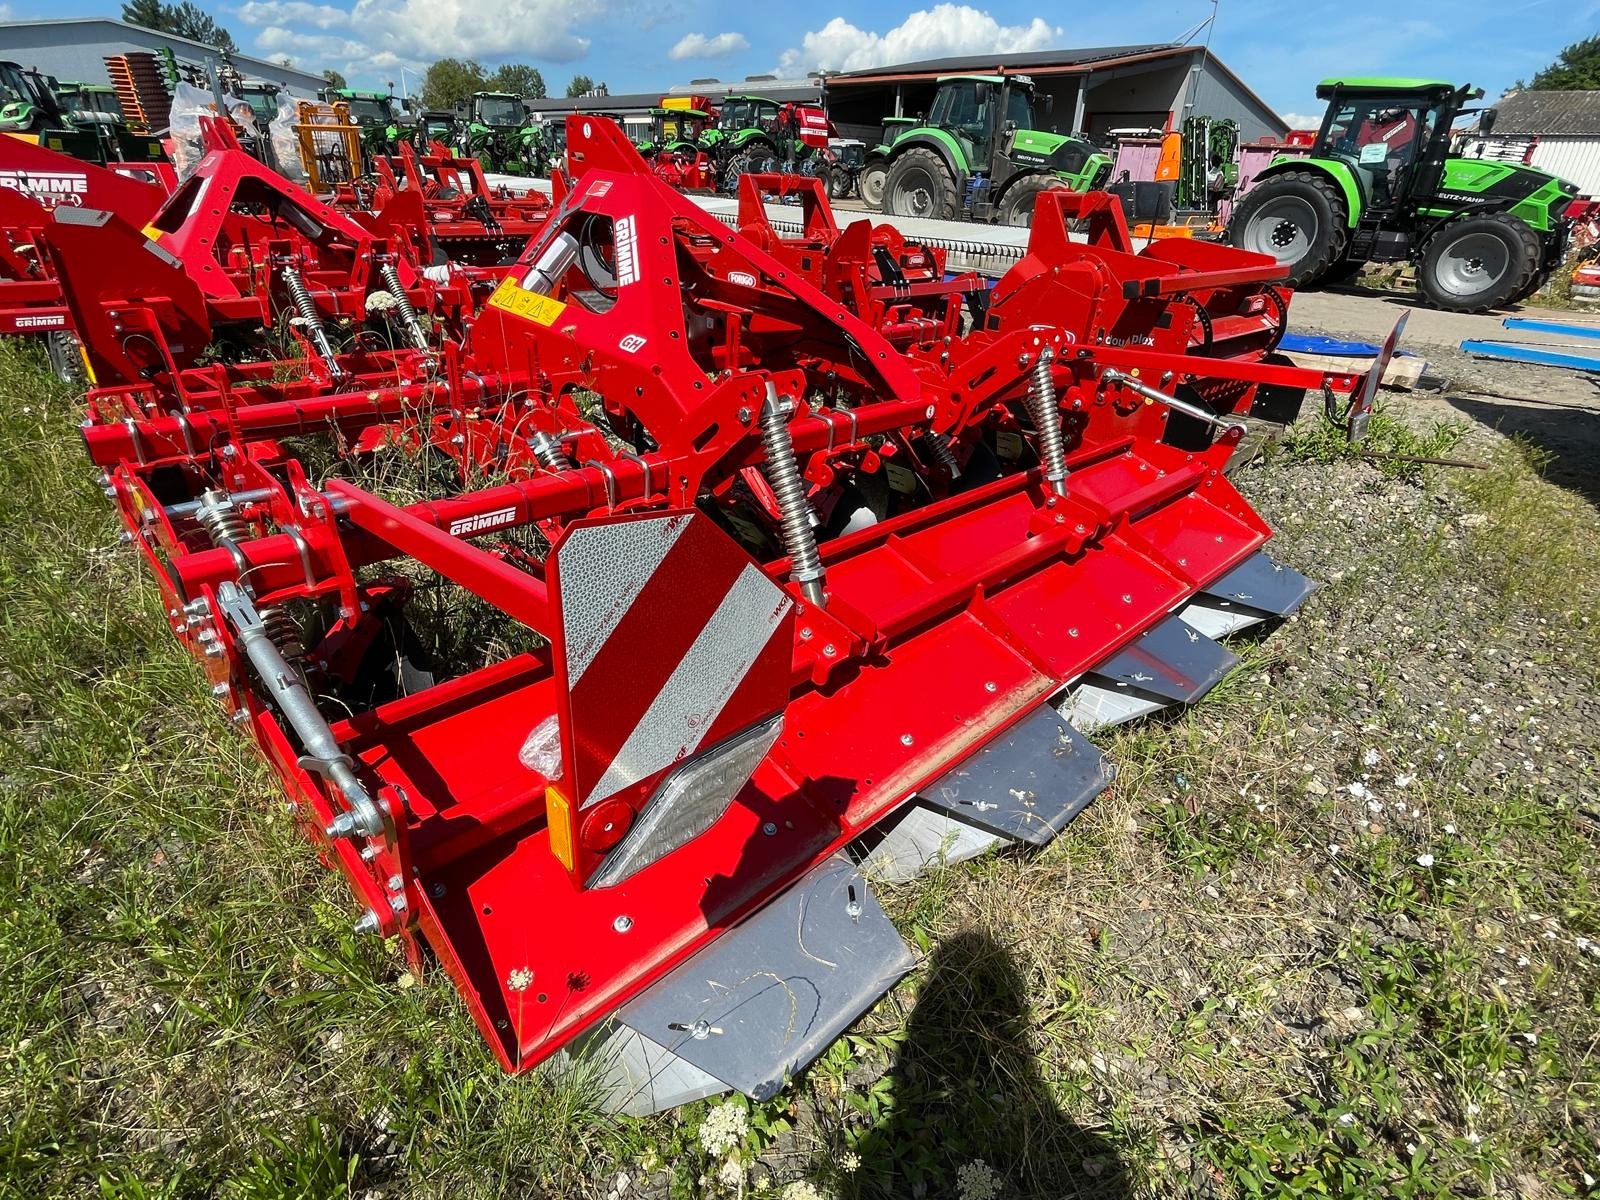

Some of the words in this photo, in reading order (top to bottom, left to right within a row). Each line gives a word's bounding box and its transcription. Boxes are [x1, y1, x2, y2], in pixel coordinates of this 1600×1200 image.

[1435, 192, 1485, 203] EUTZ-FAHR
[616, 215, 640, 287] GRIMME
[16, 316, 64, 327] GRIMME
[621, 336, 644, 351] GH
[450, 507, 516, 535] GRIMME
